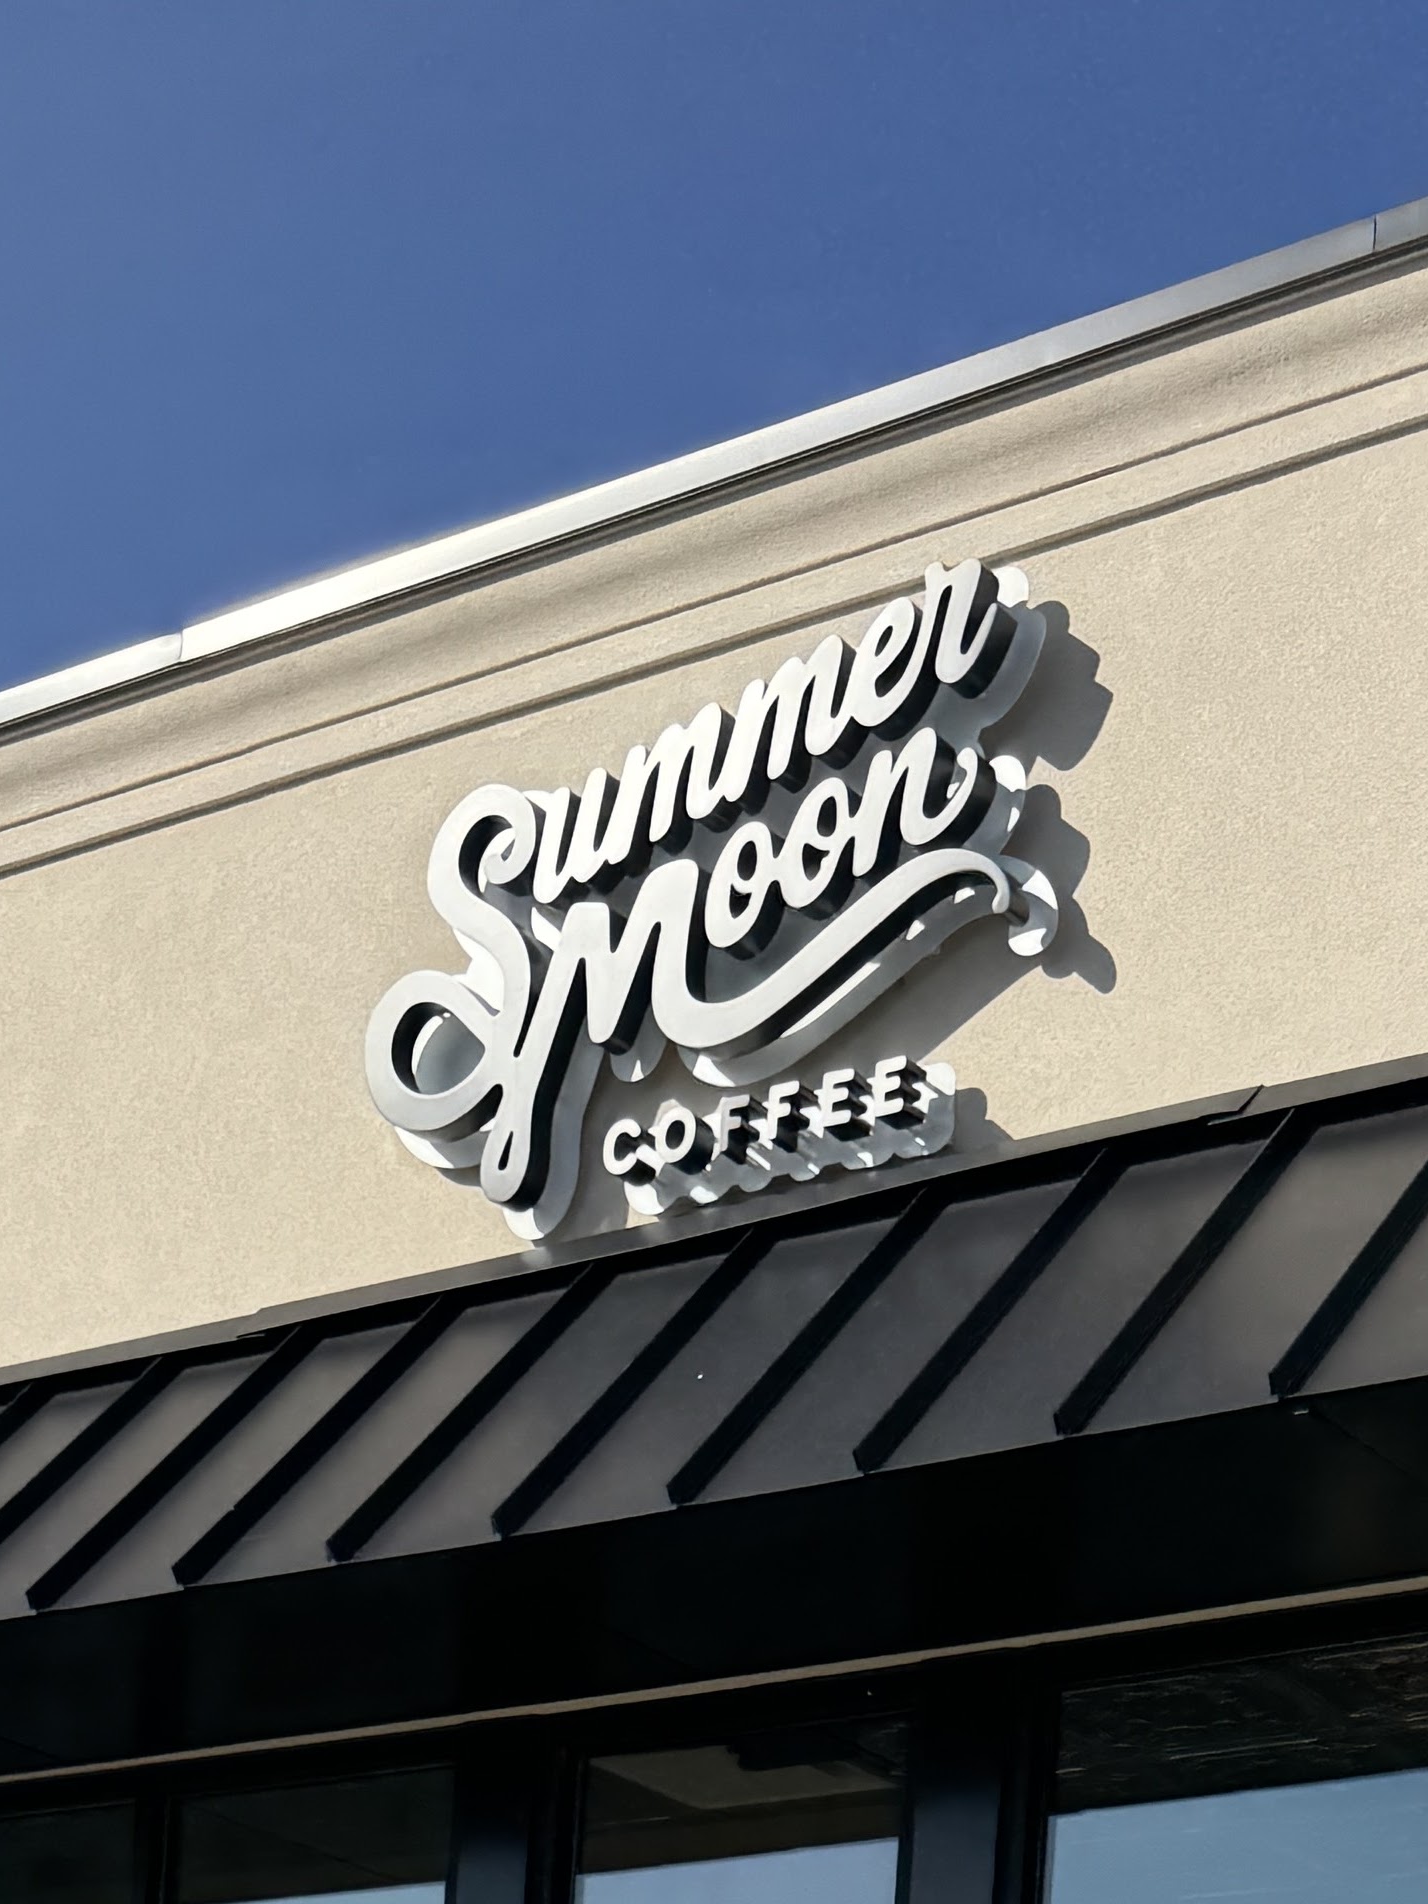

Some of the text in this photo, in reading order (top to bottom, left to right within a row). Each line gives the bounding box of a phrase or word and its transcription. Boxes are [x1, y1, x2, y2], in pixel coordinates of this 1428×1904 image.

[366, 558, 999, 1130] Summer
[479, 727, 1012, 1203] Moon
[602, 1056, 912, 1177] COFFEE
